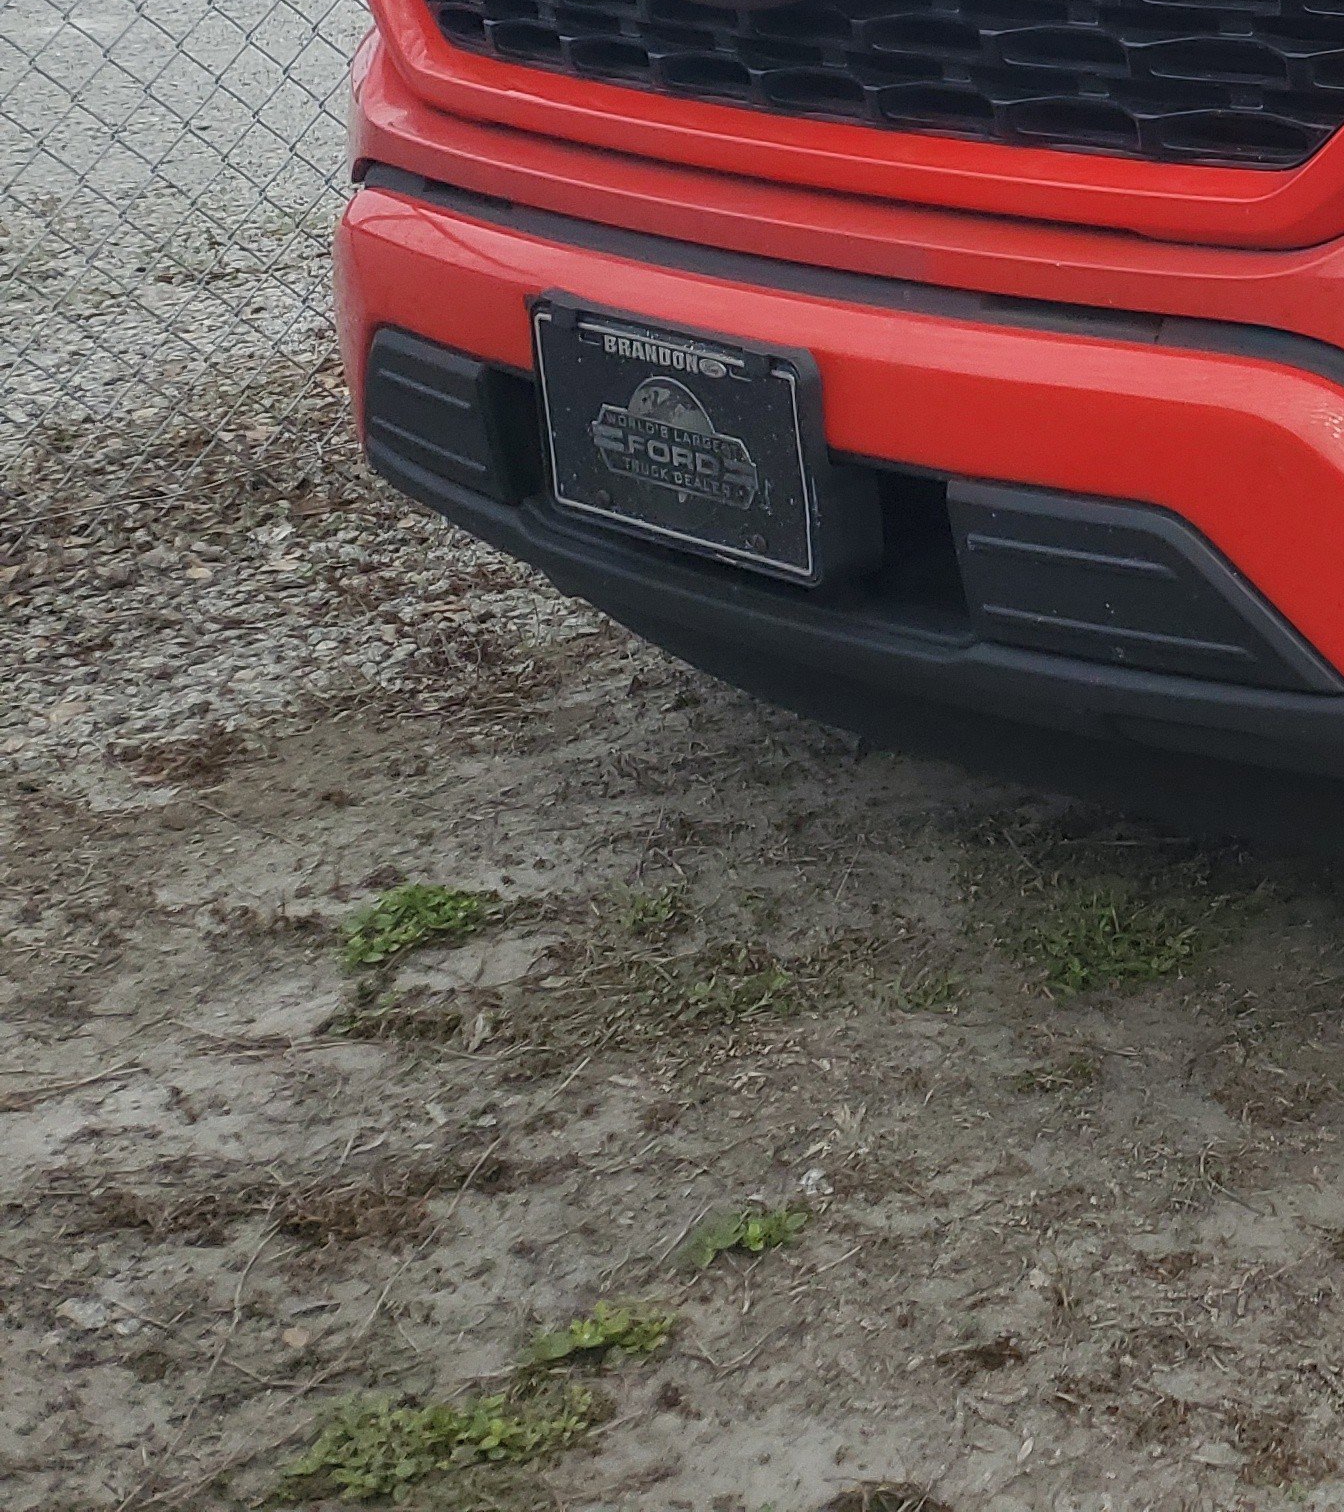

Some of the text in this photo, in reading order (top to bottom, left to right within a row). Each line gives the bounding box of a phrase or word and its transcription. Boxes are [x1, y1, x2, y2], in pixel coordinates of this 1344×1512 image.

[603, 334, 700, 374] BRANDON
[605, 412, 669, 439] WORLD'S
[627, 434, 721, 476] FORD
[623, 456, 731, 498] TRUCK DEALER
